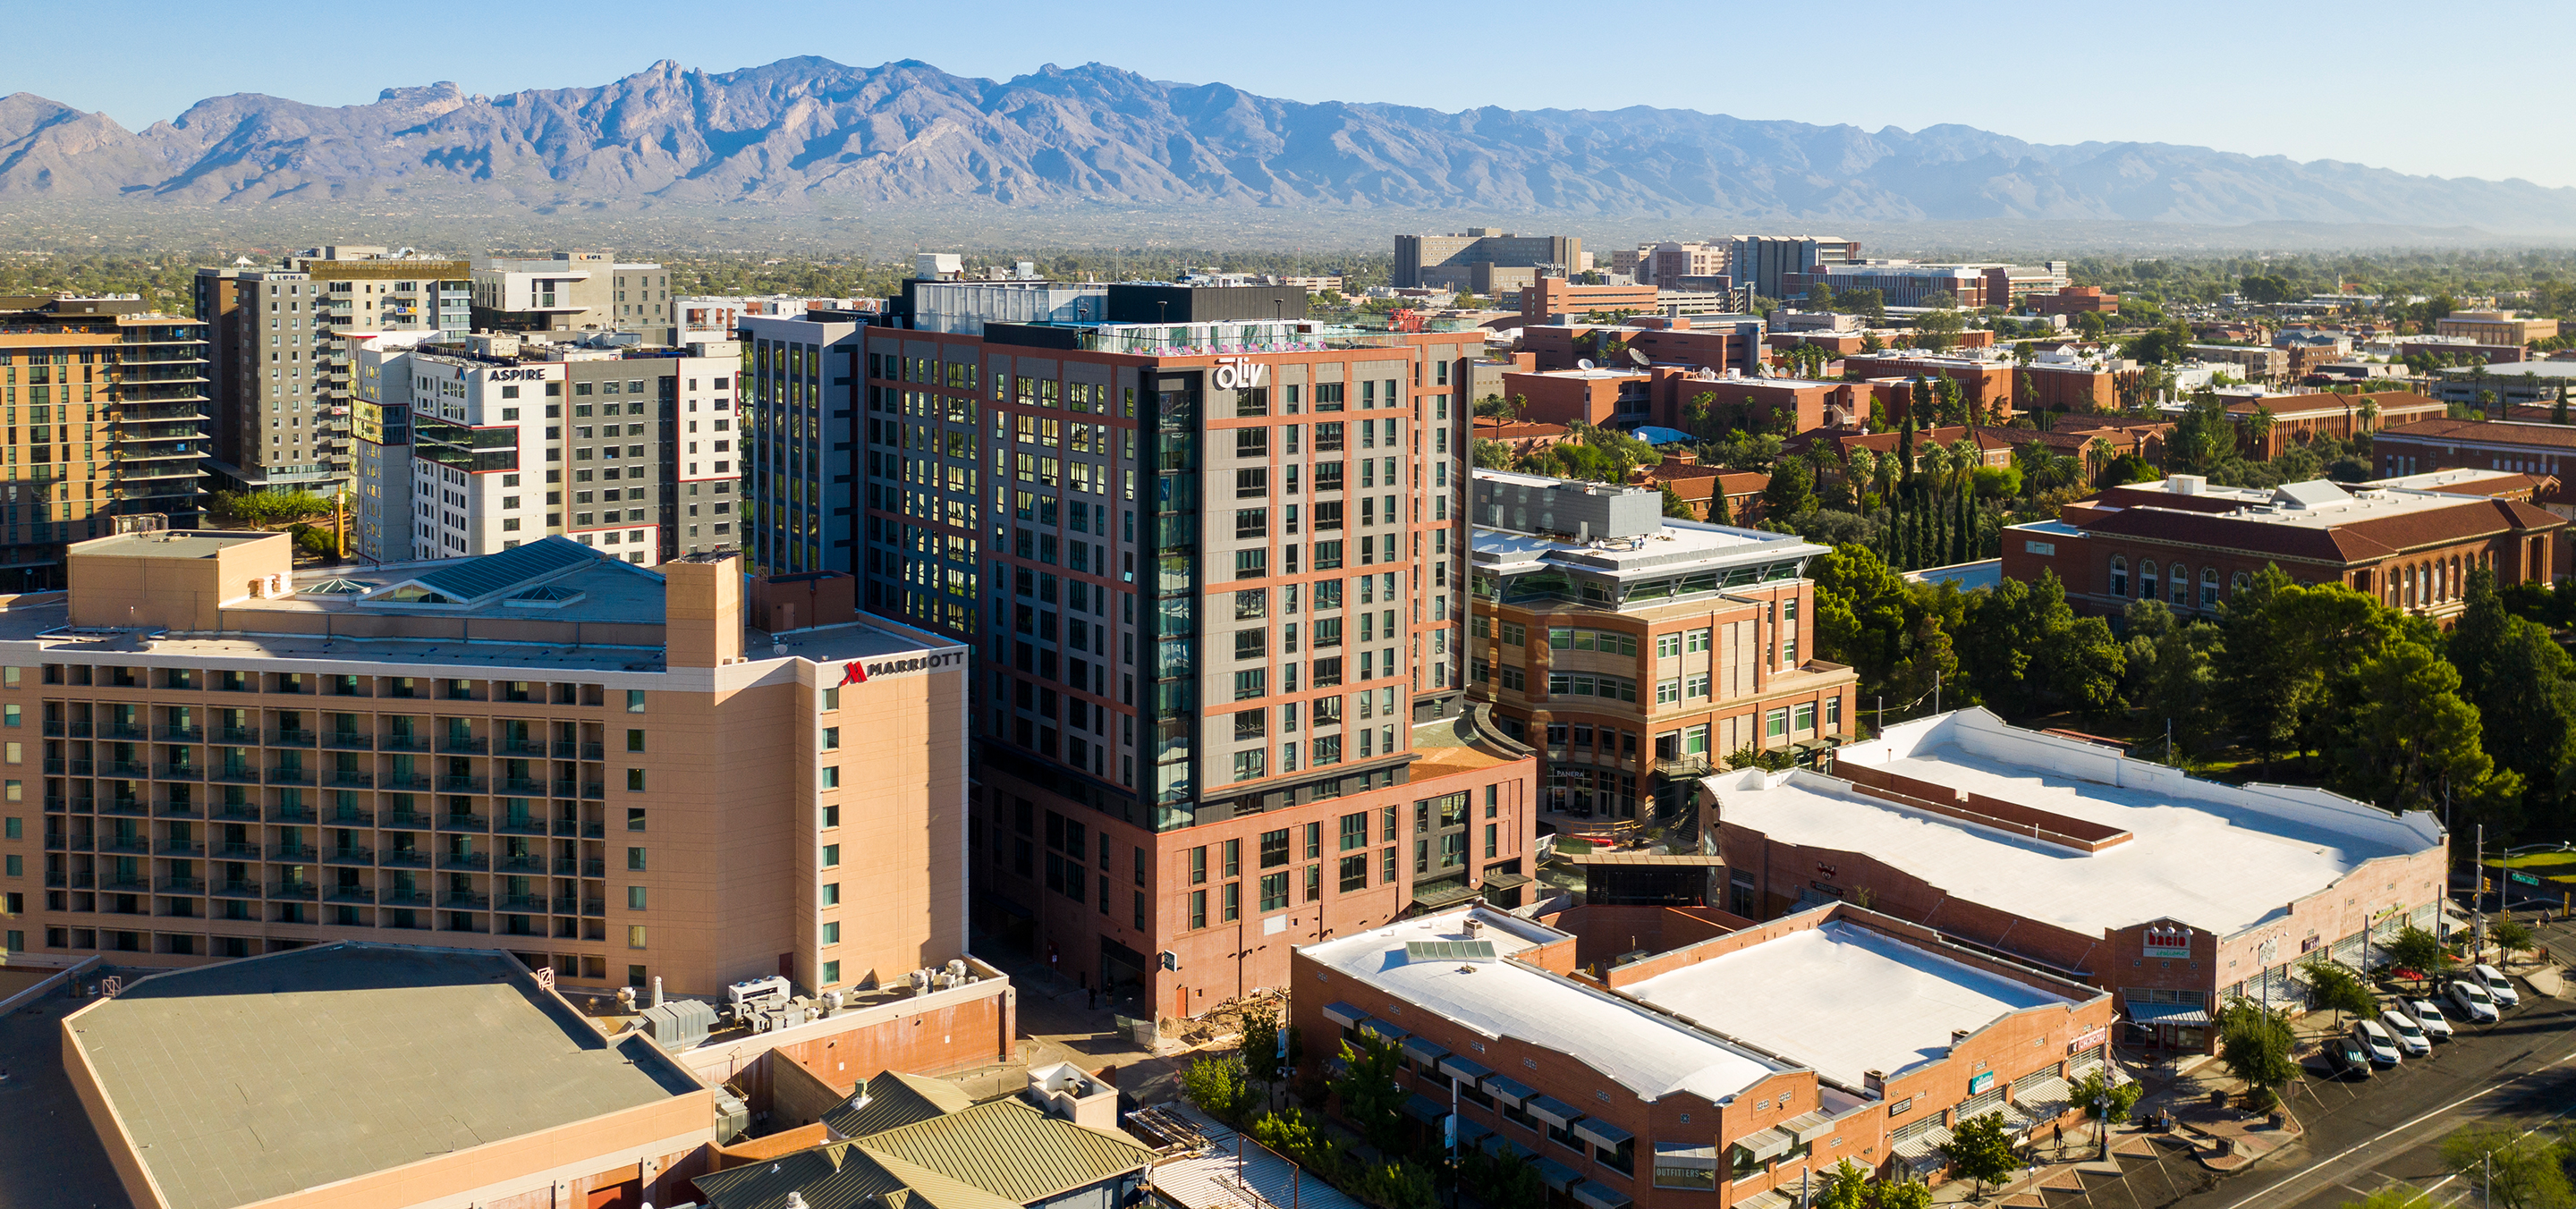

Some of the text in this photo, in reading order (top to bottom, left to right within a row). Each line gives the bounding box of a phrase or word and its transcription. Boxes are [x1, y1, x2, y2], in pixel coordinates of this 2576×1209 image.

[488, 368, 546, 382] ASPIRE
[867, 652, 963, 677] MARRIOTT
[2148, 932, 2186, 947] bacio
[1657, 1167, 1699, 1178] OUTFITTERS
